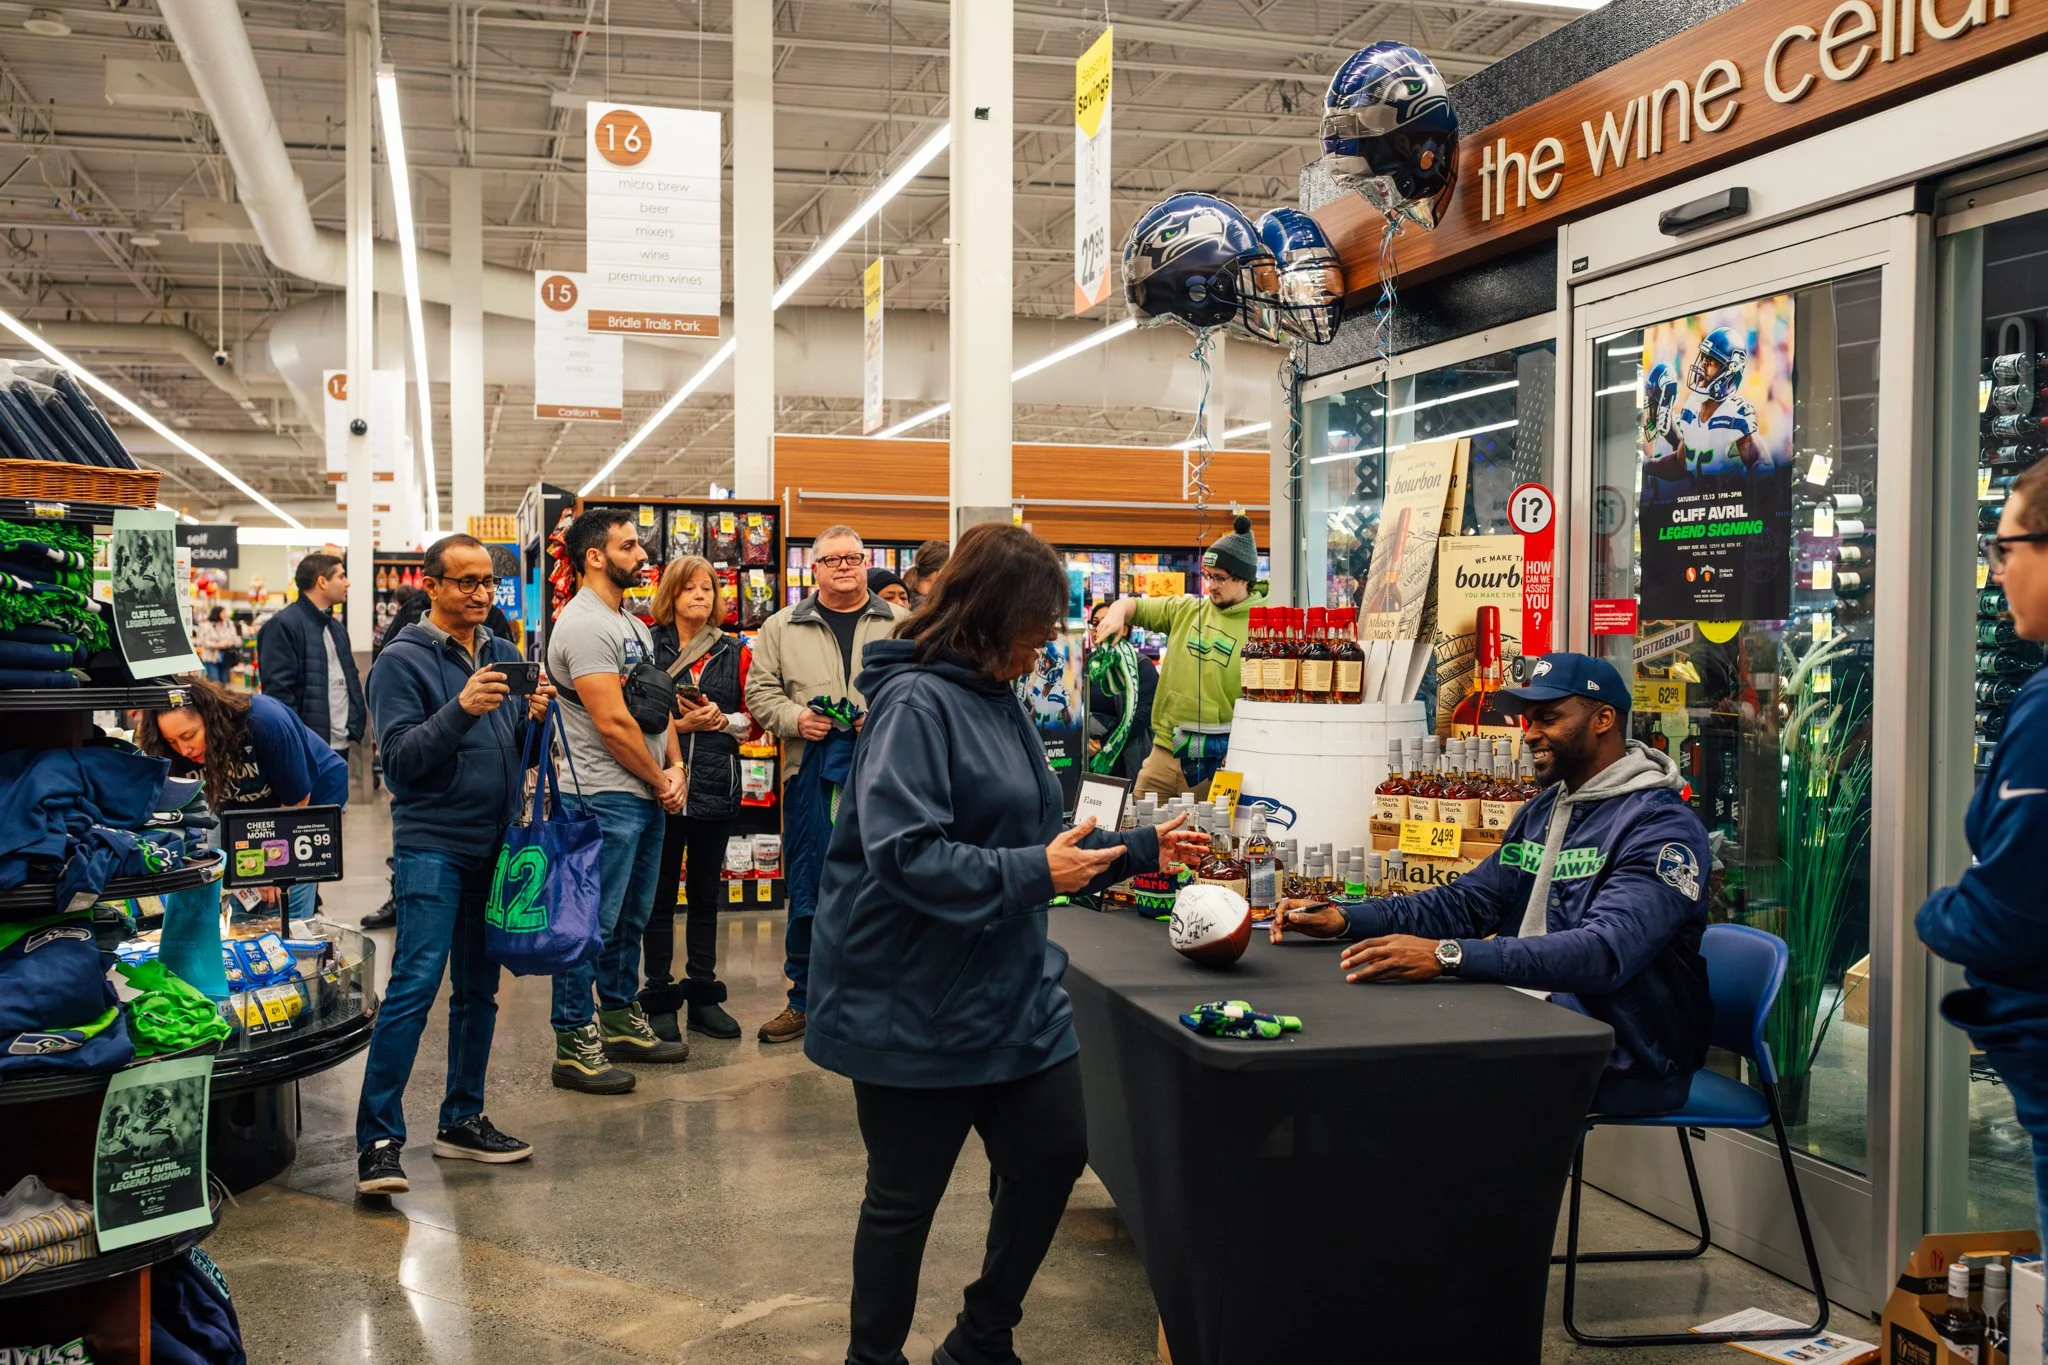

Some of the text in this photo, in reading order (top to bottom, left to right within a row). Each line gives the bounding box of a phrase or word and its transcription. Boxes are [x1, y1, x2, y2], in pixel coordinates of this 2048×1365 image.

[1078, 73, 1109, 115] savings
[605, 124, 642, 152] 16
[1478, 138, 1565, 222] the
[1582, 60, 1743, 177] wine
[618, 178, 690, 192] micro brew
[640, 202, 670, 214] beer
[636, 225, 674, 238] mixers
[640, 249, 670, 260] wine
[608, 271, 703, 286] premium wines
[547, 284, 572, 303] 15
[608, 316, 700, 332] Bridle Trails Park
[1394, 470, 1442, 494] bourbon
[1672, 504, 1748, 524] CLIFF AVRIL
[1658, 520, 1764, 540] LEGEND SIGNING
[186, 533, 208, 546] self
[1403, 561, 1429, 588] LUMEN
[1526, 560, 1552, 574] HOW
[1455, 564, 1522, 588] bourb
[1526, 575, 1550, 584] CAN WE
[1525, 584, 1550, 593] ASSIST
[1525, 594, 1550, 610] YOU
[131, 611, 149, 619] CLIFF
[1533, 612, 1542, 630] ?
[126, 619, 150, 628] LEGEND
[1642, 628, 1691, 657] FITZGERALD
[1084, 796, 1102, 806] Please
[247, 821, 275, 829] CHEESE
[247, 831, 275, 840] MONTH
[485, 843, 548, 933] 12
[1135, 878, 1169, 890] Mark
[122, 1166, 151, 1180] CLIFF
[152, 1161, 180, 1174] AVRIL
[109, 1167, 192, 1193] LEGEND SIGNING
